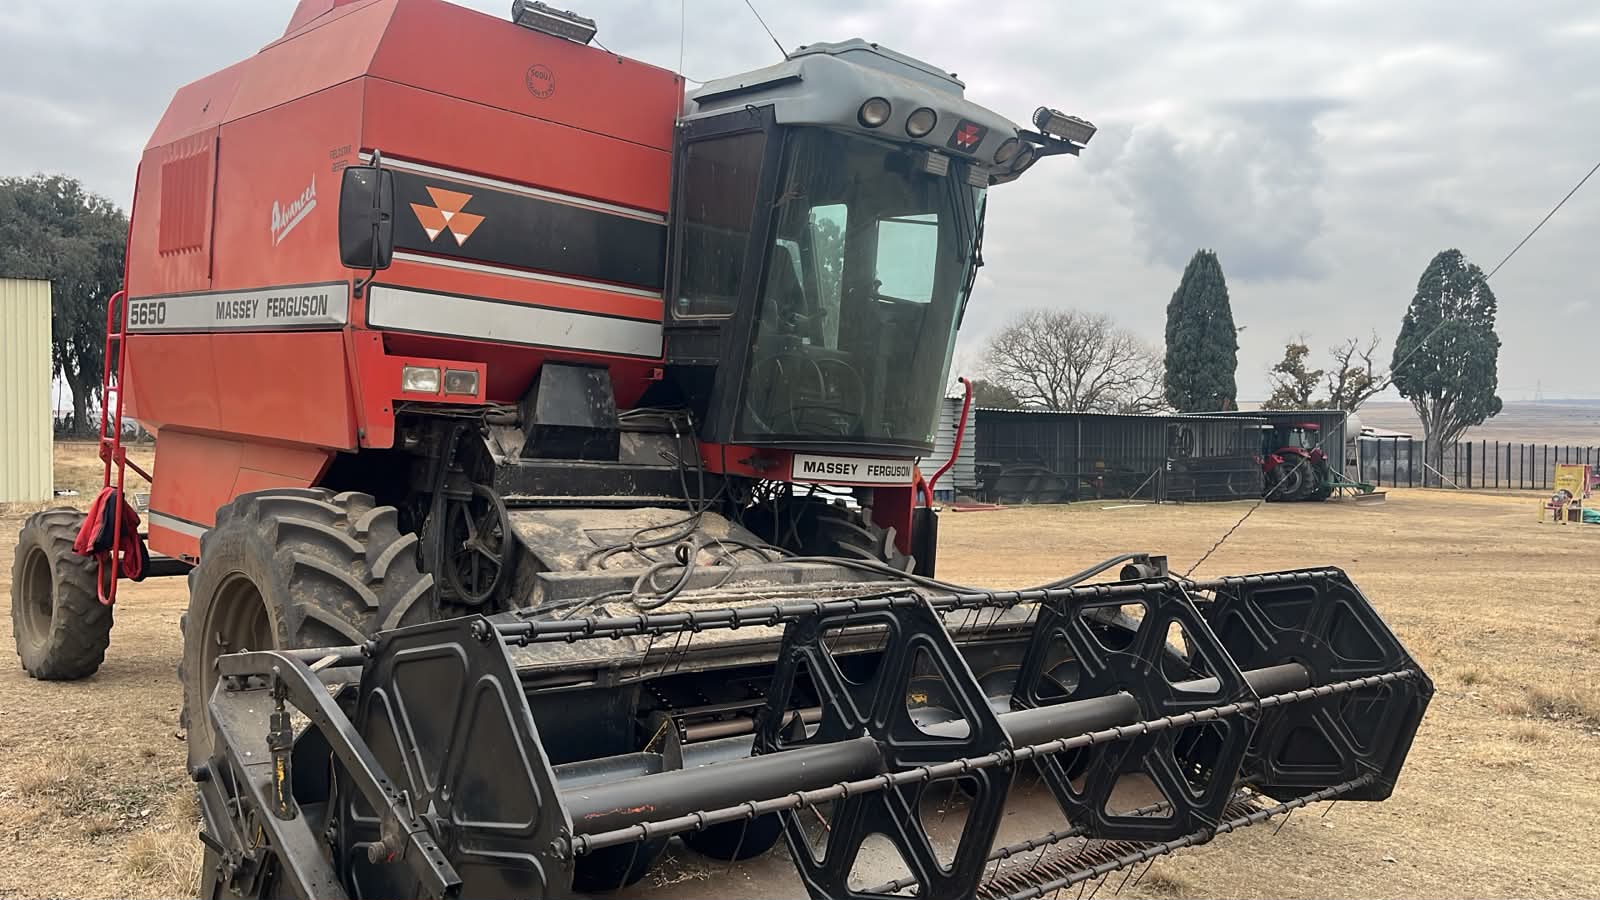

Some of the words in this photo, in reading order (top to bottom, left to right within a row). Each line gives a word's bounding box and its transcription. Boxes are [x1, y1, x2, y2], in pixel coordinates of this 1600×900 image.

[271, 172, 316, 247] Advanced
[130, 302, 166, 325] 5650
[216, 300, 259, 320] MASSEY
[266, 294, 328, 318] FERGUSON
[803, 461, 858, 475] MASSEY
[867, 465, 911, 477] FERGUSON
